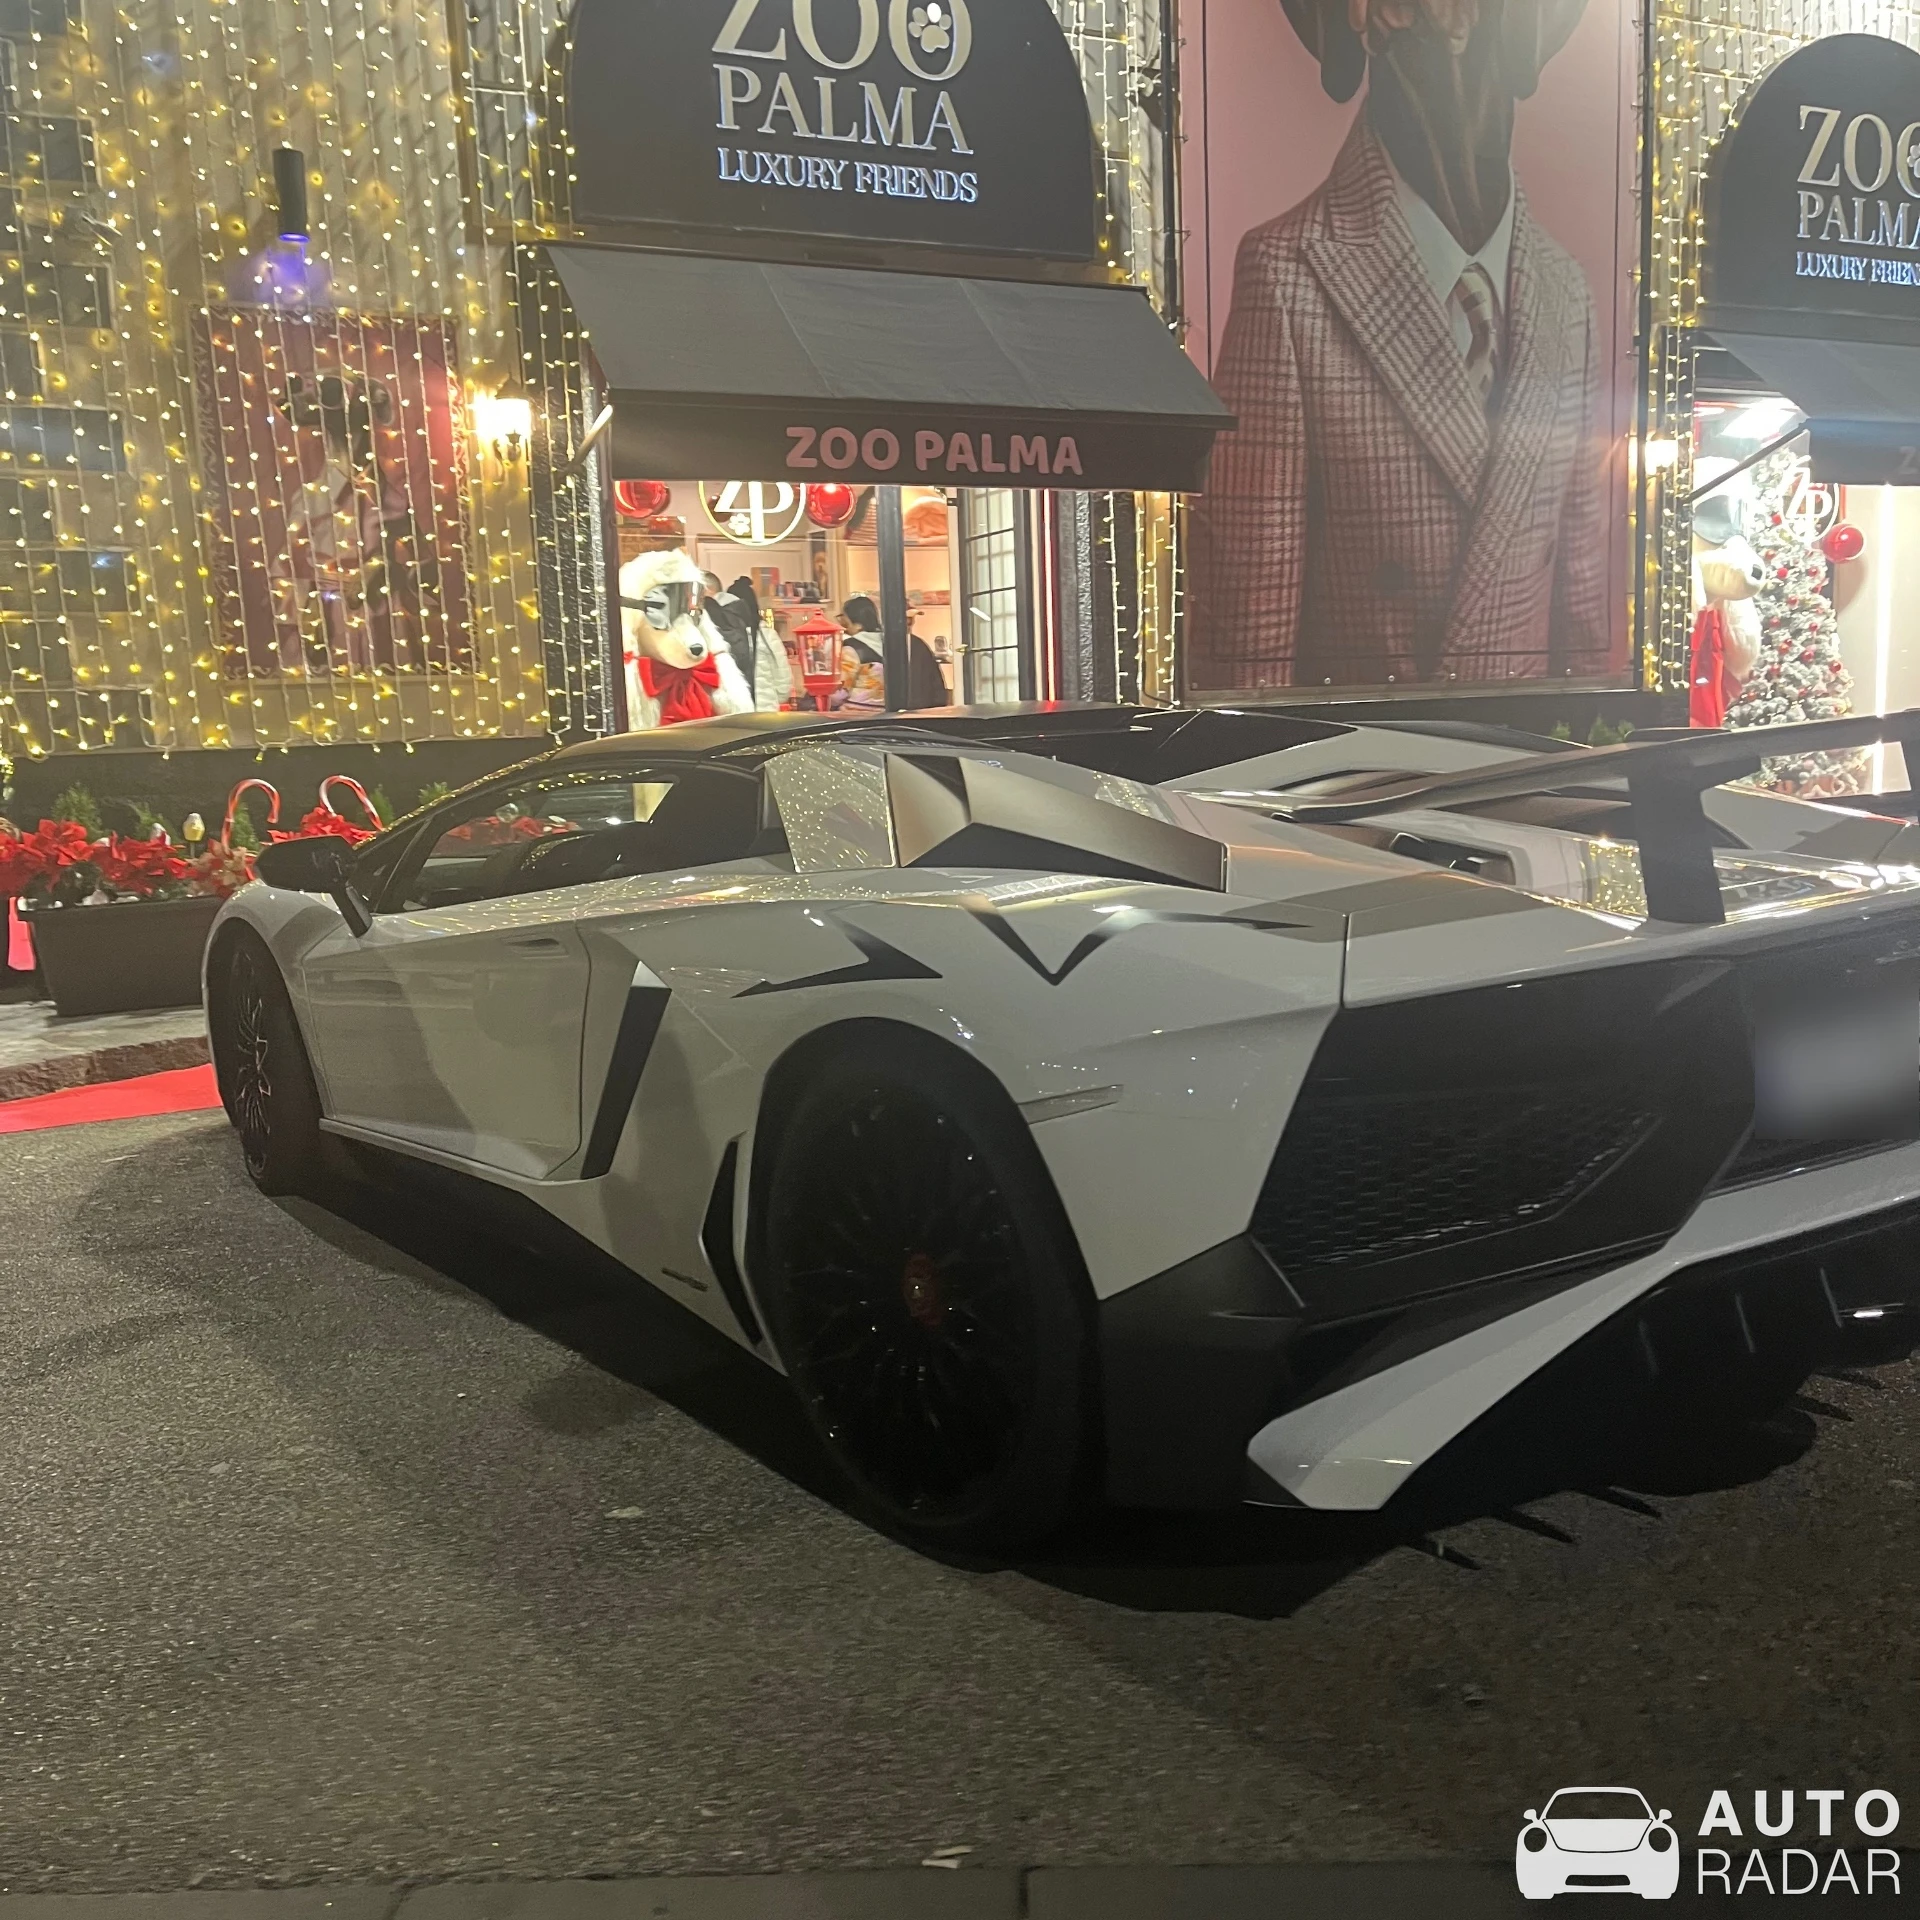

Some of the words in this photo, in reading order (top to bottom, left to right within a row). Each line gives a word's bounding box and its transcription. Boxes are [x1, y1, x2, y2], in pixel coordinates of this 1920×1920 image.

[712, 0, 973, 81] ZOO
[712, 63, 974, 154] PALMA
[717, 147, 849, 190] LUXURY
[854, 161, 979, 203] FRIENDS
[1796, 251, 1867, 281] LUXURY
[786, 427, 899, 470] ZOO
[914, 430, 1083, 475] PALMA
